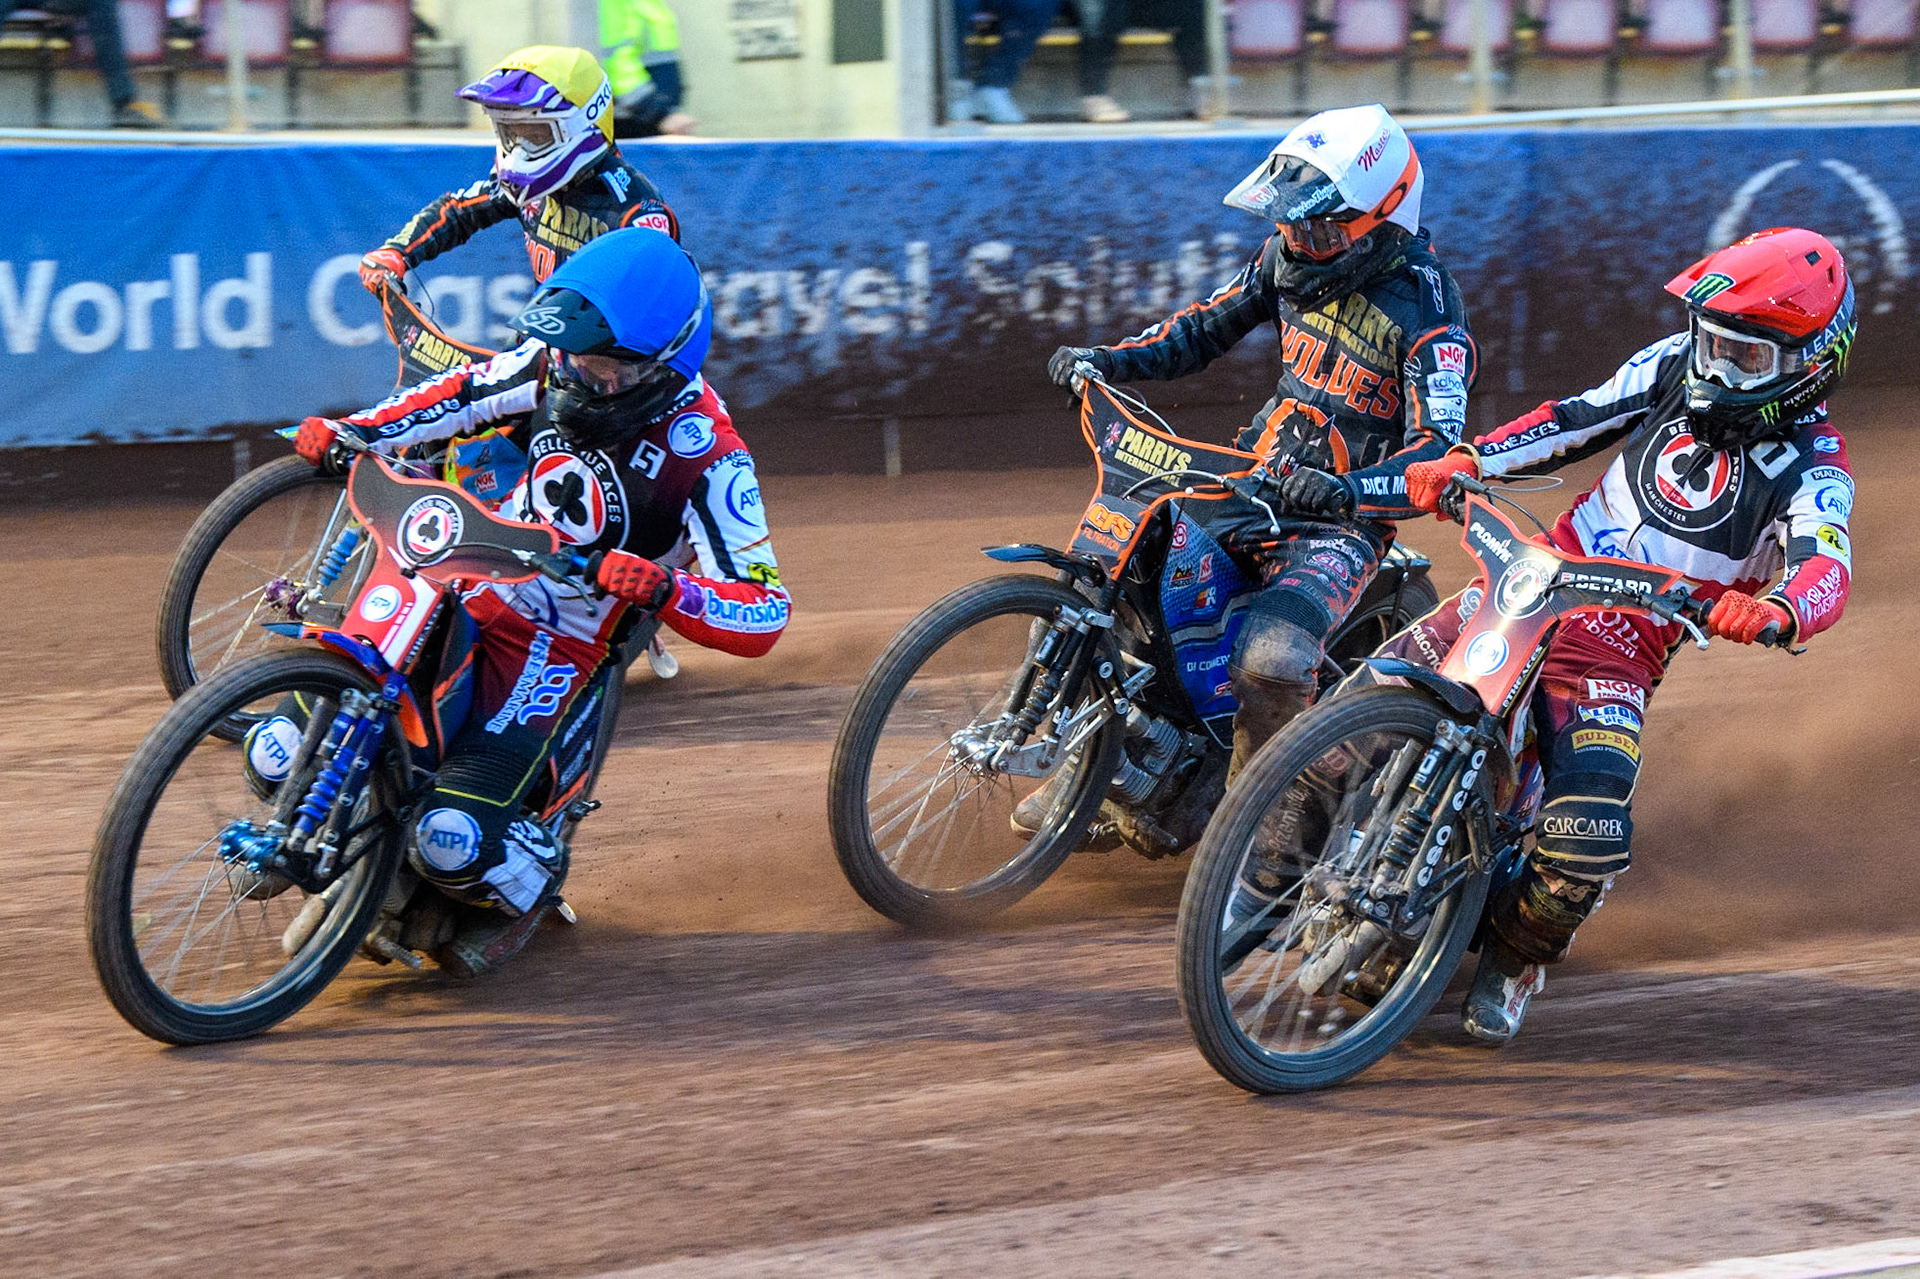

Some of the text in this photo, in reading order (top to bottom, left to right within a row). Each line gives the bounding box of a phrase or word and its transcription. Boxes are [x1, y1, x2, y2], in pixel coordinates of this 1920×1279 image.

[1320, 291, 1403, 363] ARRYS
[1438, 345, 1464, 366] NGK
[1119, 427, 1192, 474] PARRYS
[1361, 476, 1390, 496] DICK
[602, 481, 622, 524] ACES
[1644, 482, 1687, 523] MANCHESTER
[1086, 503, 1135, 542] CFS
[708, 589, 787, 624] burnside
[1594, 680, 1642, 701] NGK
[1575, 732, 1637, 754] BUD-BET
[427, 829, 467, 851] ATPI
[1544, 816, 1623, 837] GARCAREK
